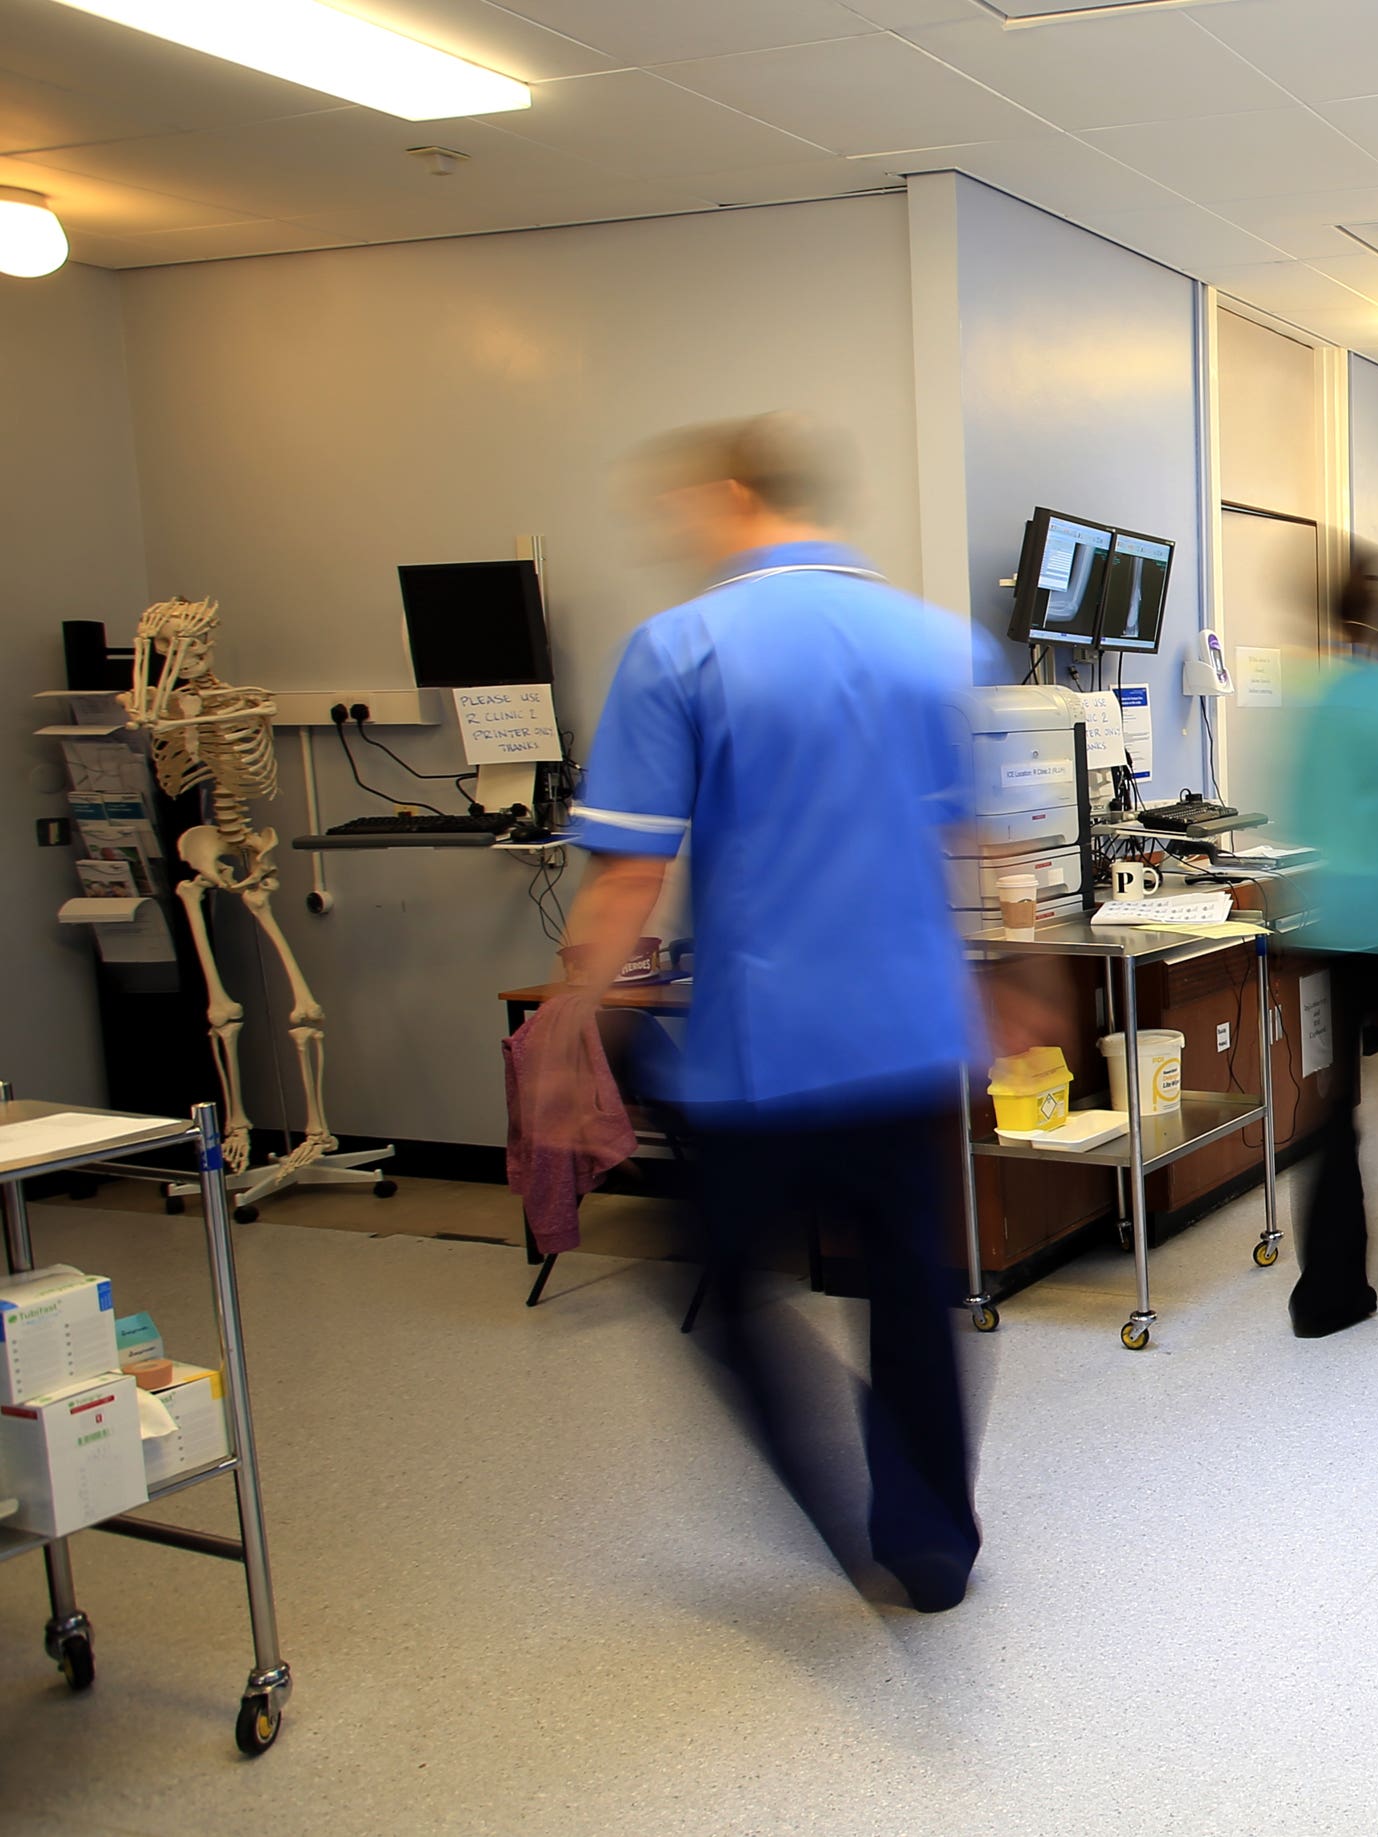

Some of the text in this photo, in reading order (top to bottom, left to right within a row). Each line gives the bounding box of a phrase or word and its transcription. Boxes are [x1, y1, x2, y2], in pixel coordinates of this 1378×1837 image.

[460, 693, 540, 707] PLEASE USE
[485, 711, 523, 722] CLINIC
[530, 709, 538, 719] 2
[1102, 711, 1109, 723] 2
[473, 727, 530, 740] PRINTER
[499, 742, 538, 752] THANKS
[1116, 872, 1134, 893] P
[621, 959, 651, 975] HEROES
